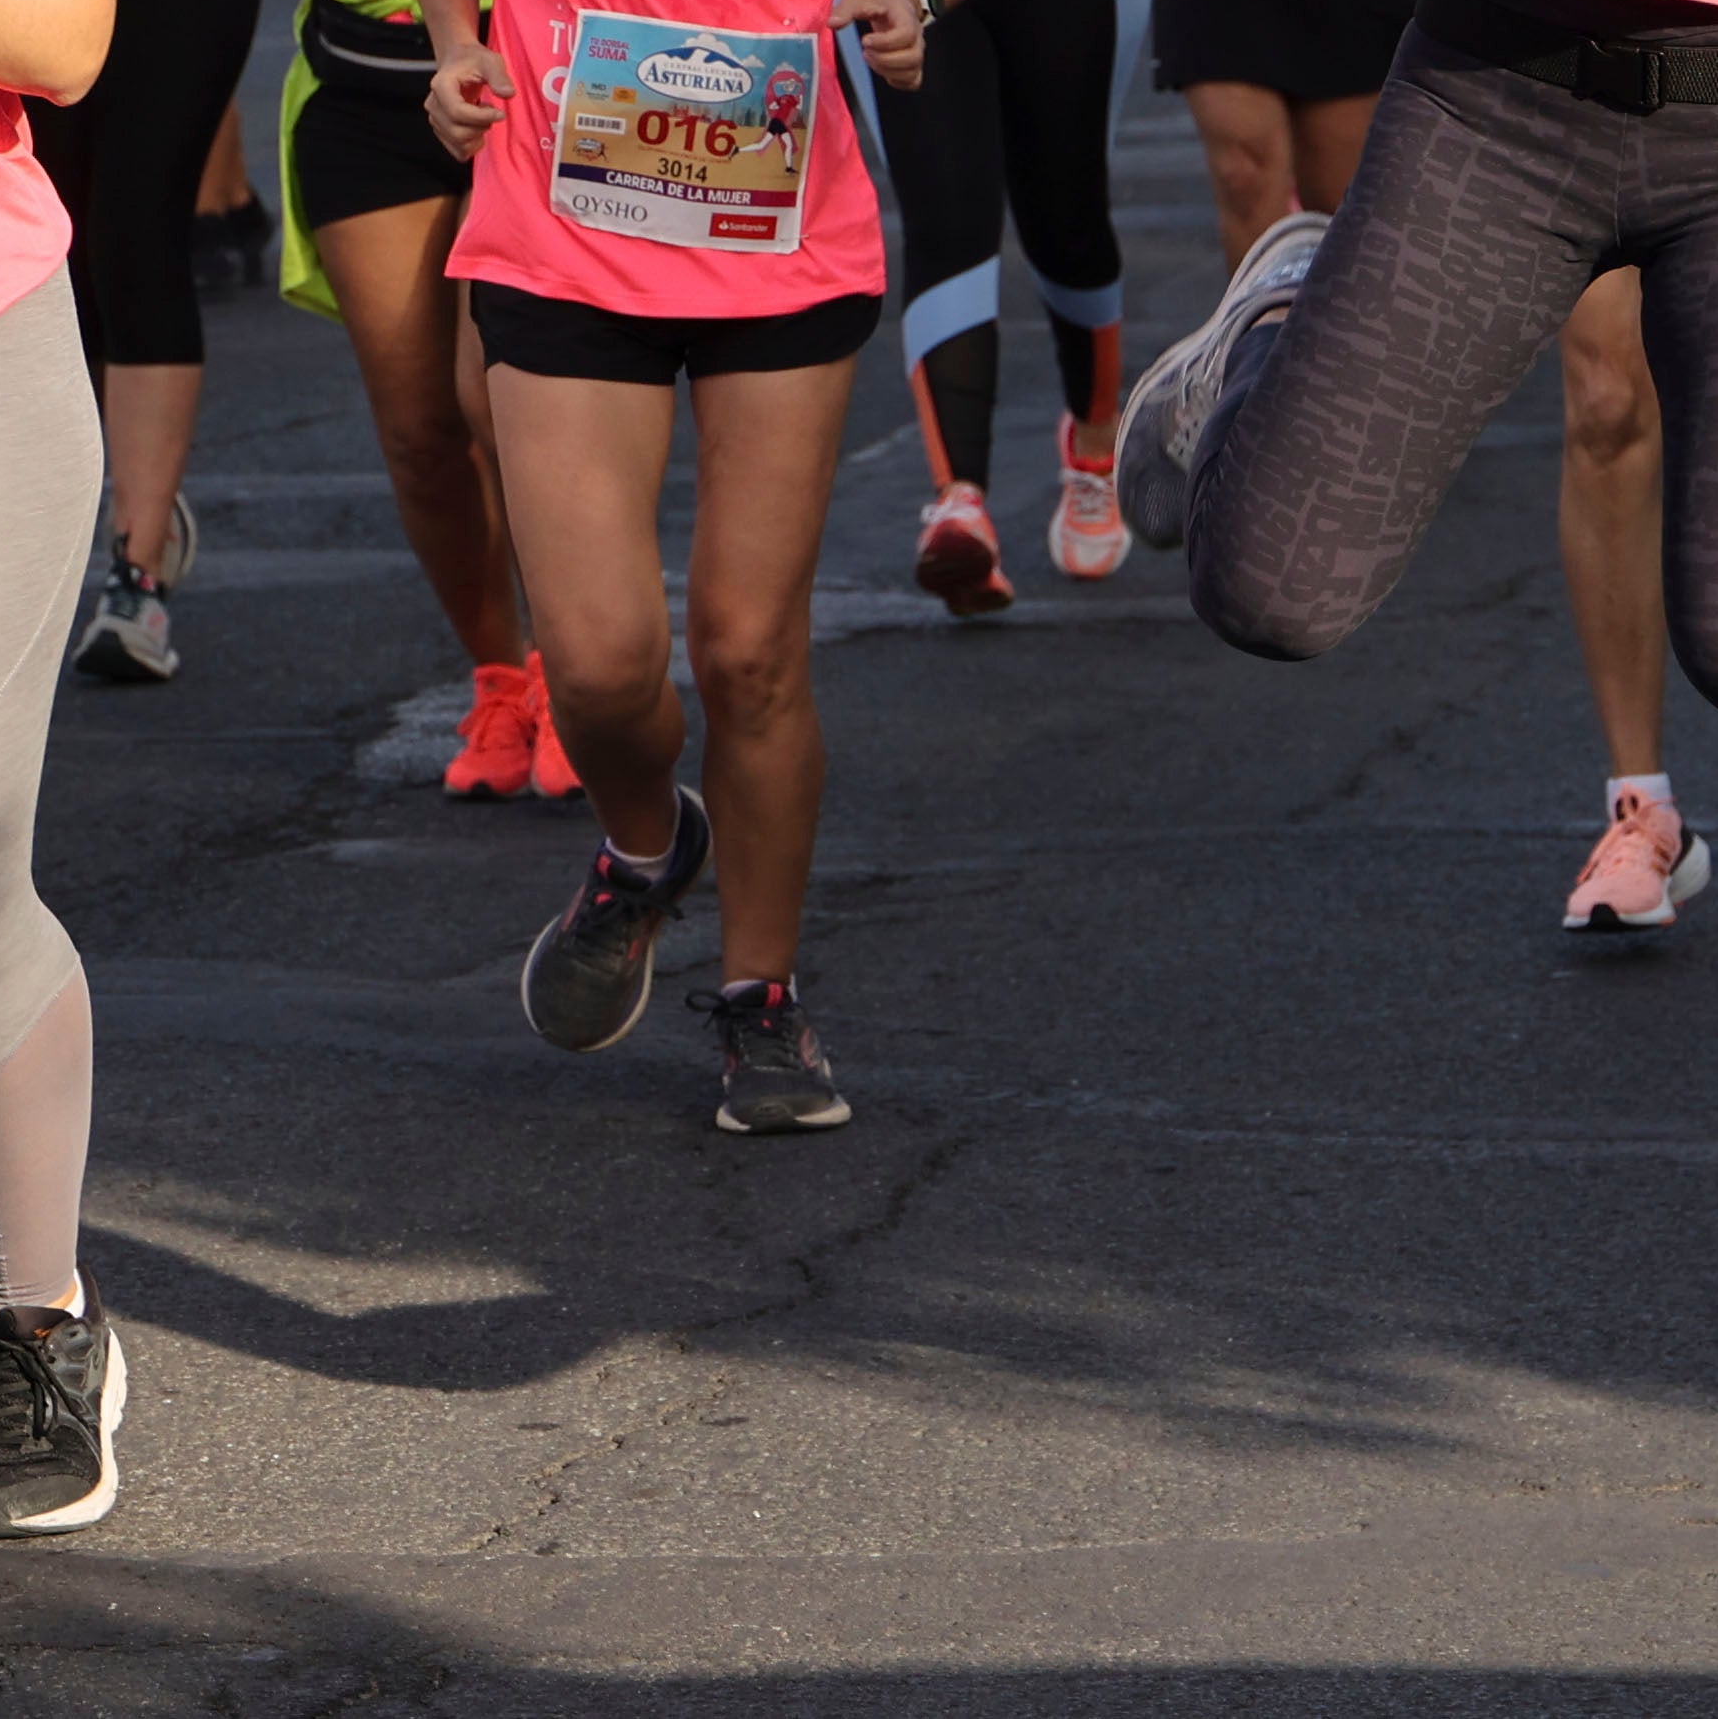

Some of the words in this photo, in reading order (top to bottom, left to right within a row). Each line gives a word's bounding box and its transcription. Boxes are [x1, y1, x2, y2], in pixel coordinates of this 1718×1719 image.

[588, 45, 628, 62] SUMA
[644, 61, 745, 94] ASTURIANA
[636, 109, 739, 158] 016
[656, 157, 708, 183] 3014
[605, 170, 665, 194] CARRERA
[667, 183, 685, 199] DE
[687, 186, 705, 202] LA
[707, 189, 751, 205] MUJER
[572, 193, 649, 223] OYSHO
[728, 222, 769, 233] Santander
